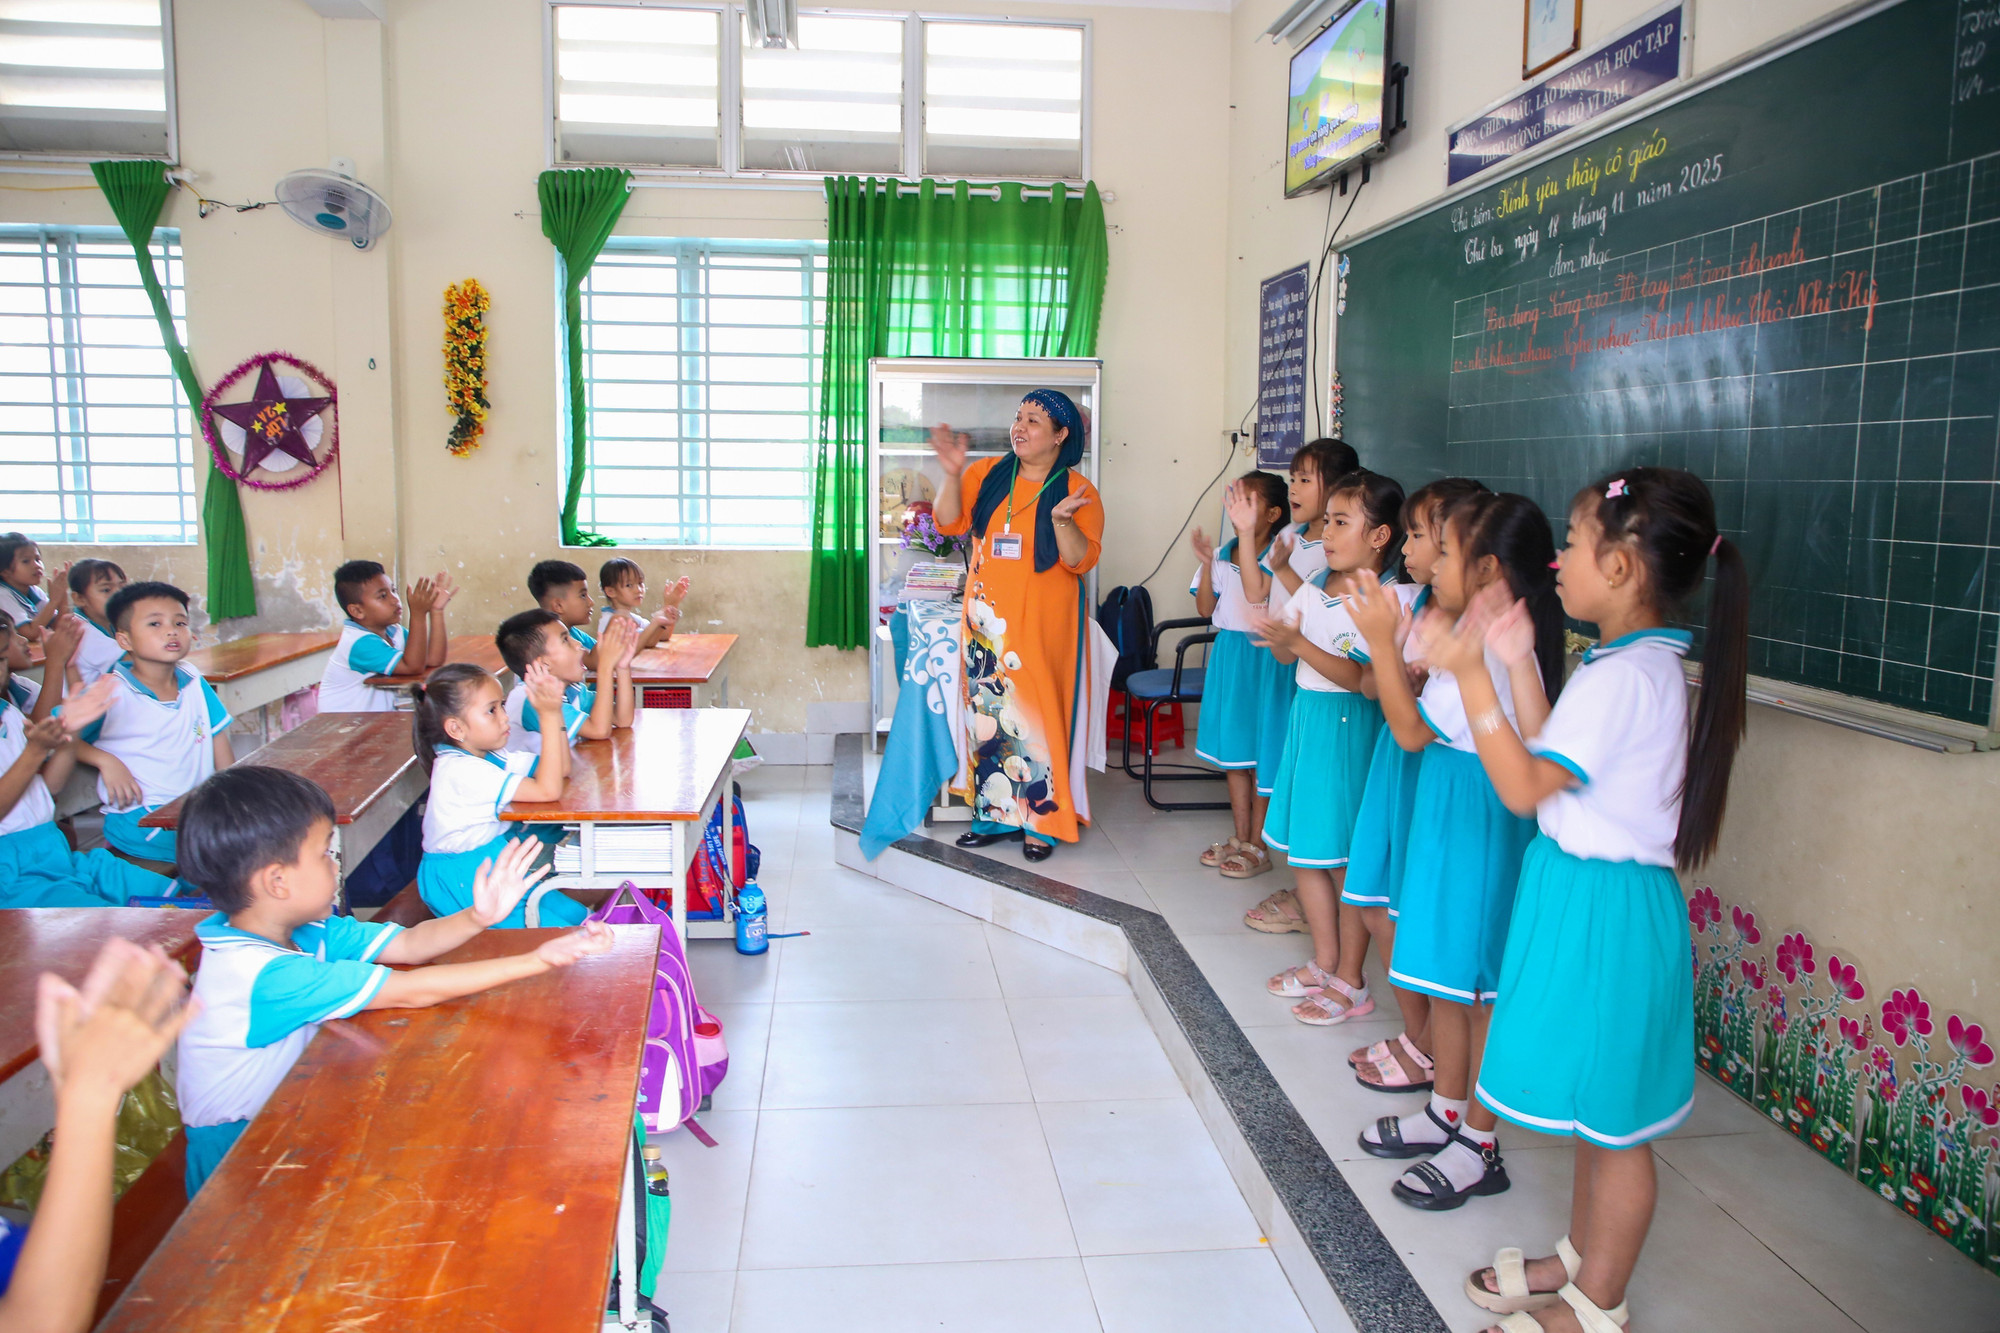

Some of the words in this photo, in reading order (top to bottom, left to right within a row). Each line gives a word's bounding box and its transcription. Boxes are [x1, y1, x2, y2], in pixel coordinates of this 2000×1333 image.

[1536, 86, 1557, 111] LAO
[1594, 53, 1611, 79] VÀ
[1614, 41, 1642, 70] HỌC
[1645, 23, 1674, 53] TẬP
[1490, 236, 1504, 258] ba
[1514, 226, 1540, 262] ngày
[1547, 214, 1560, 238] 18
[1571, 197, 1607, 236] tháng
[1611, 190, 1624, 215] 11
[1637, 182, 1673, 206] năm
[1678, 153, 1724, 193] 2025
[1496, 176, 1530, 218] Kính
[1536, 176, 1559, 214] yêu
[1566, 157, 1601, 196] thầy
[1605, 147, 1623, 176] cô
[1628, 128, 1667, 182] giáo
[1508, 303, 1540, 335] dụng
[1640, 276, 1671, 312] tay
[1700, 258, 1732, 286] âm
[1738, 226, 1805, 276] thanh
[1549, 242, 1576, 278] Âm
[1580, 237, 1612, 270] nhạc
[1700, 294, 1745, 333] khúc
[257, 405, 276, 423] 2A
